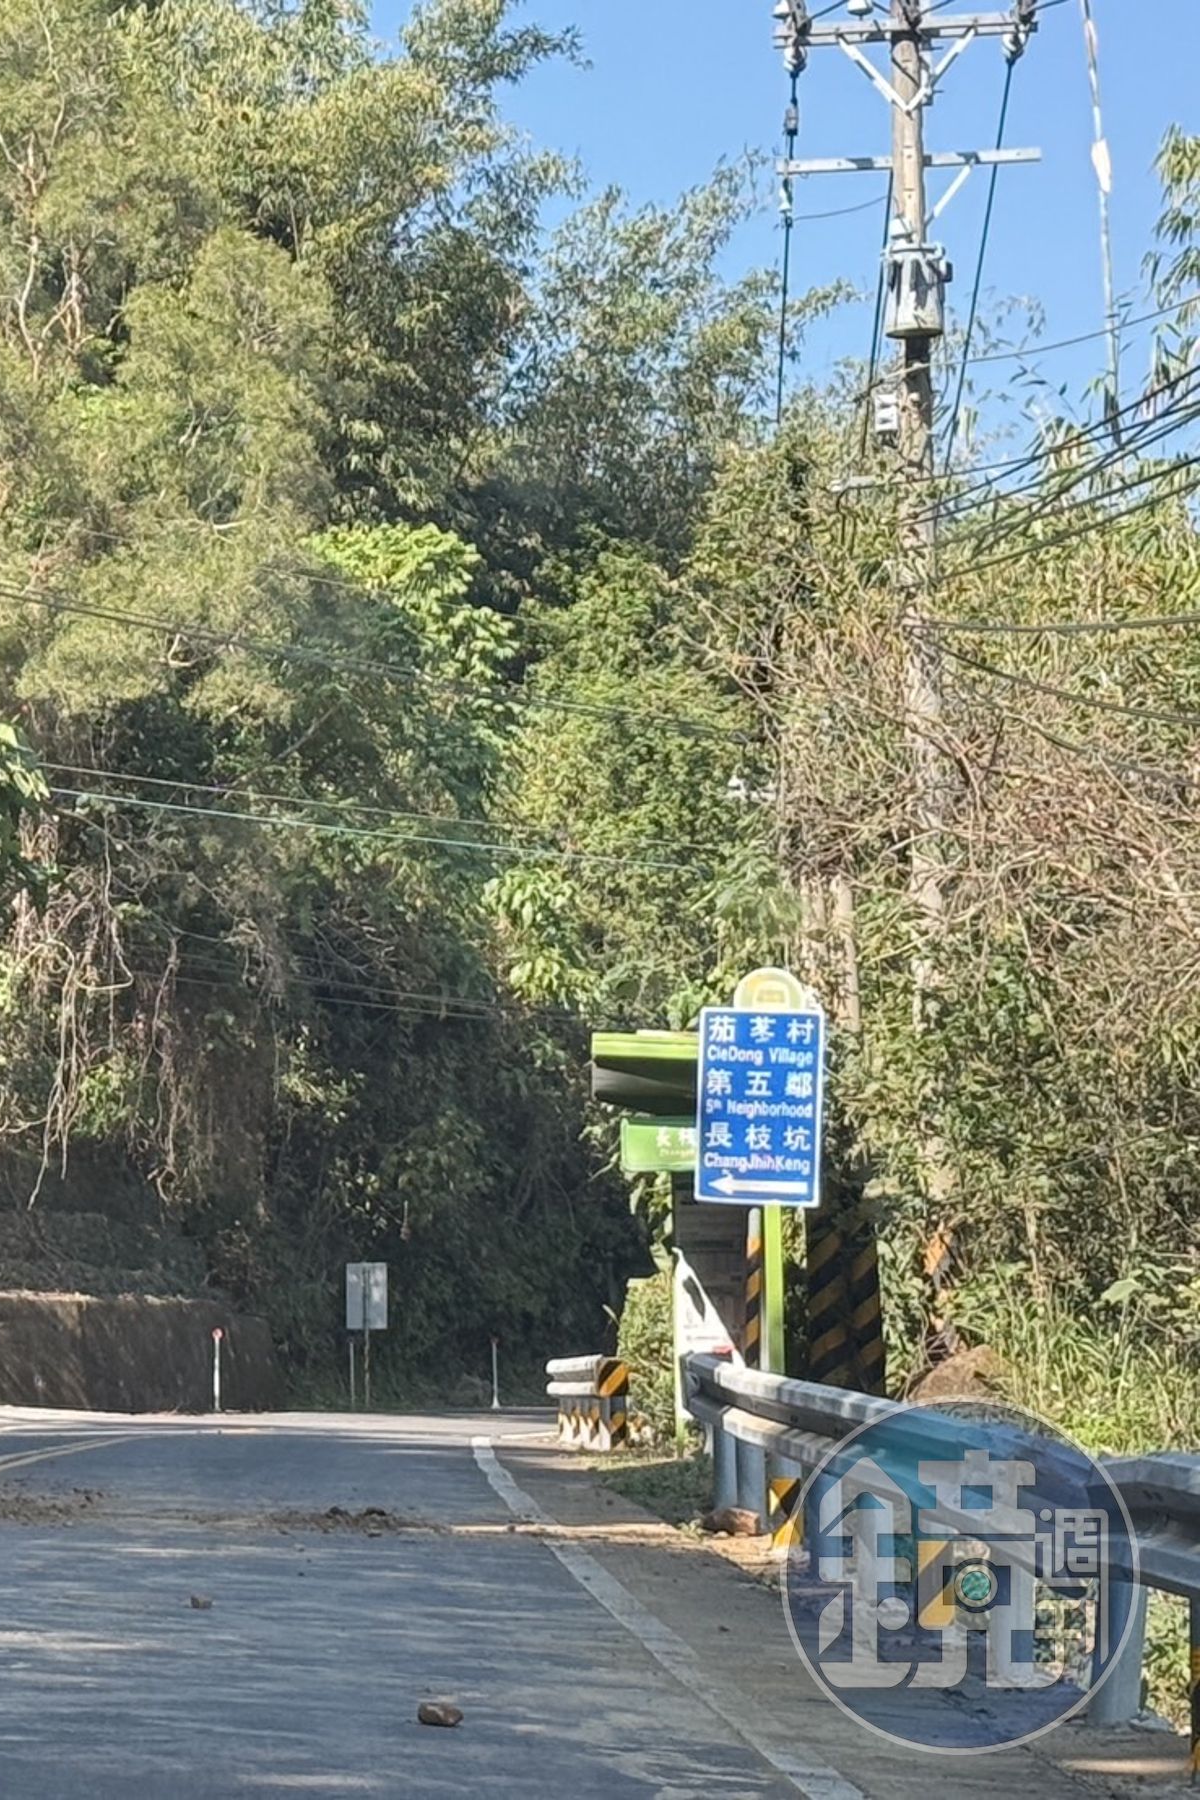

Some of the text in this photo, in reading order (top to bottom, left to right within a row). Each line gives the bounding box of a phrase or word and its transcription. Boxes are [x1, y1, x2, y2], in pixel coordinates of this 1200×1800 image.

[708, 1015, 815, 1045] 茄苳村
[768, 1047, 814, 1068] Village
[706, 1067, 813, 1098] 第五鄰
[726, 1098, 813, 1119] Neighborhood
[704, 1121, 812, 1151] 長枝坑
[703, 1152, 811, 1175] ChangJhihKeng
